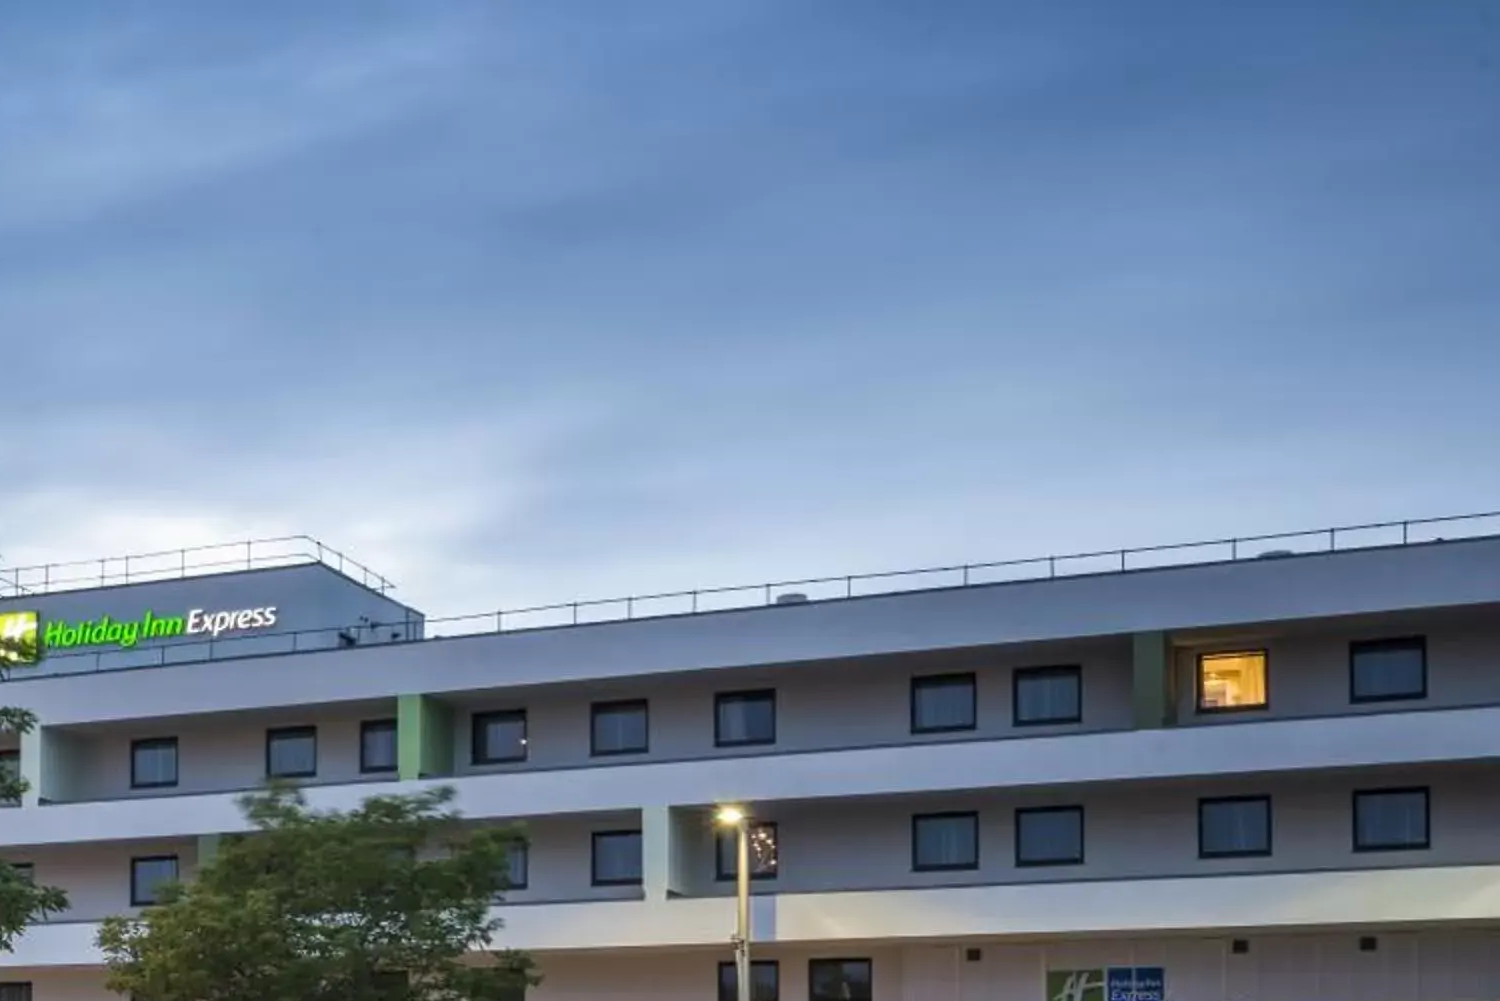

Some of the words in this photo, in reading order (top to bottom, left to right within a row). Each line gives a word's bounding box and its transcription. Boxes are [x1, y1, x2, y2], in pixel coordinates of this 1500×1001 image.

[45, 614, 138, 648] Holiday
[143, 609, 183, 637] Inn
[186, 605, 277, 637] Express
